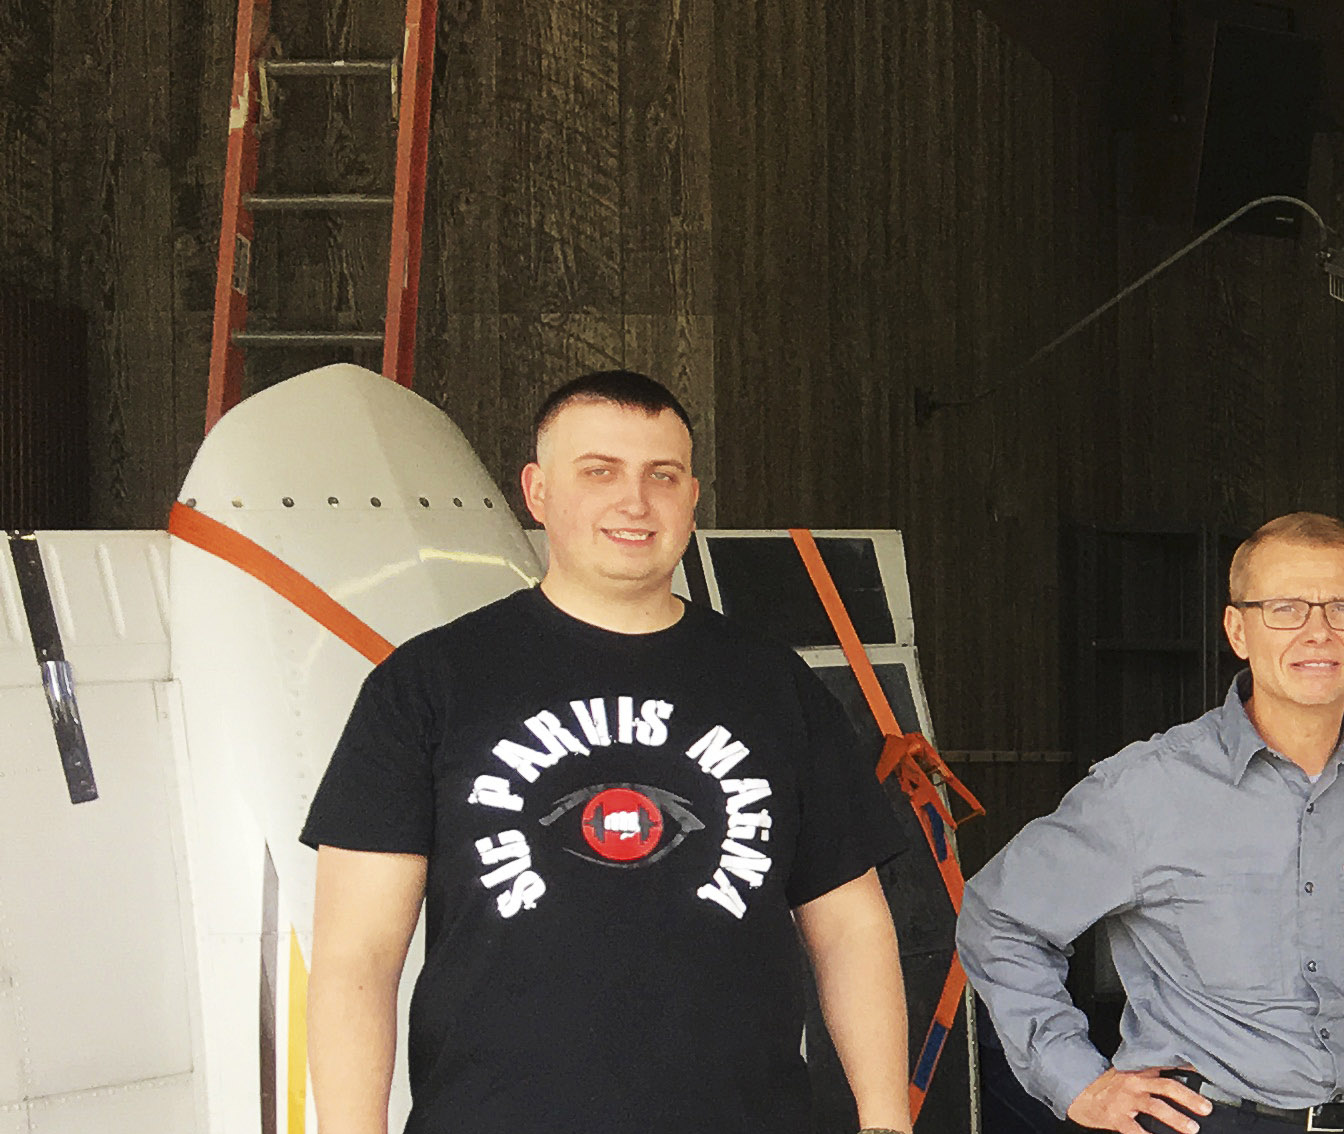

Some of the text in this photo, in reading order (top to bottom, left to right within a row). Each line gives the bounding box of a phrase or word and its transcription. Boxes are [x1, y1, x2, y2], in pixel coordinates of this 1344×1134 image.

[467, 695, 772, 919] SIC PARVIS MAGNA
